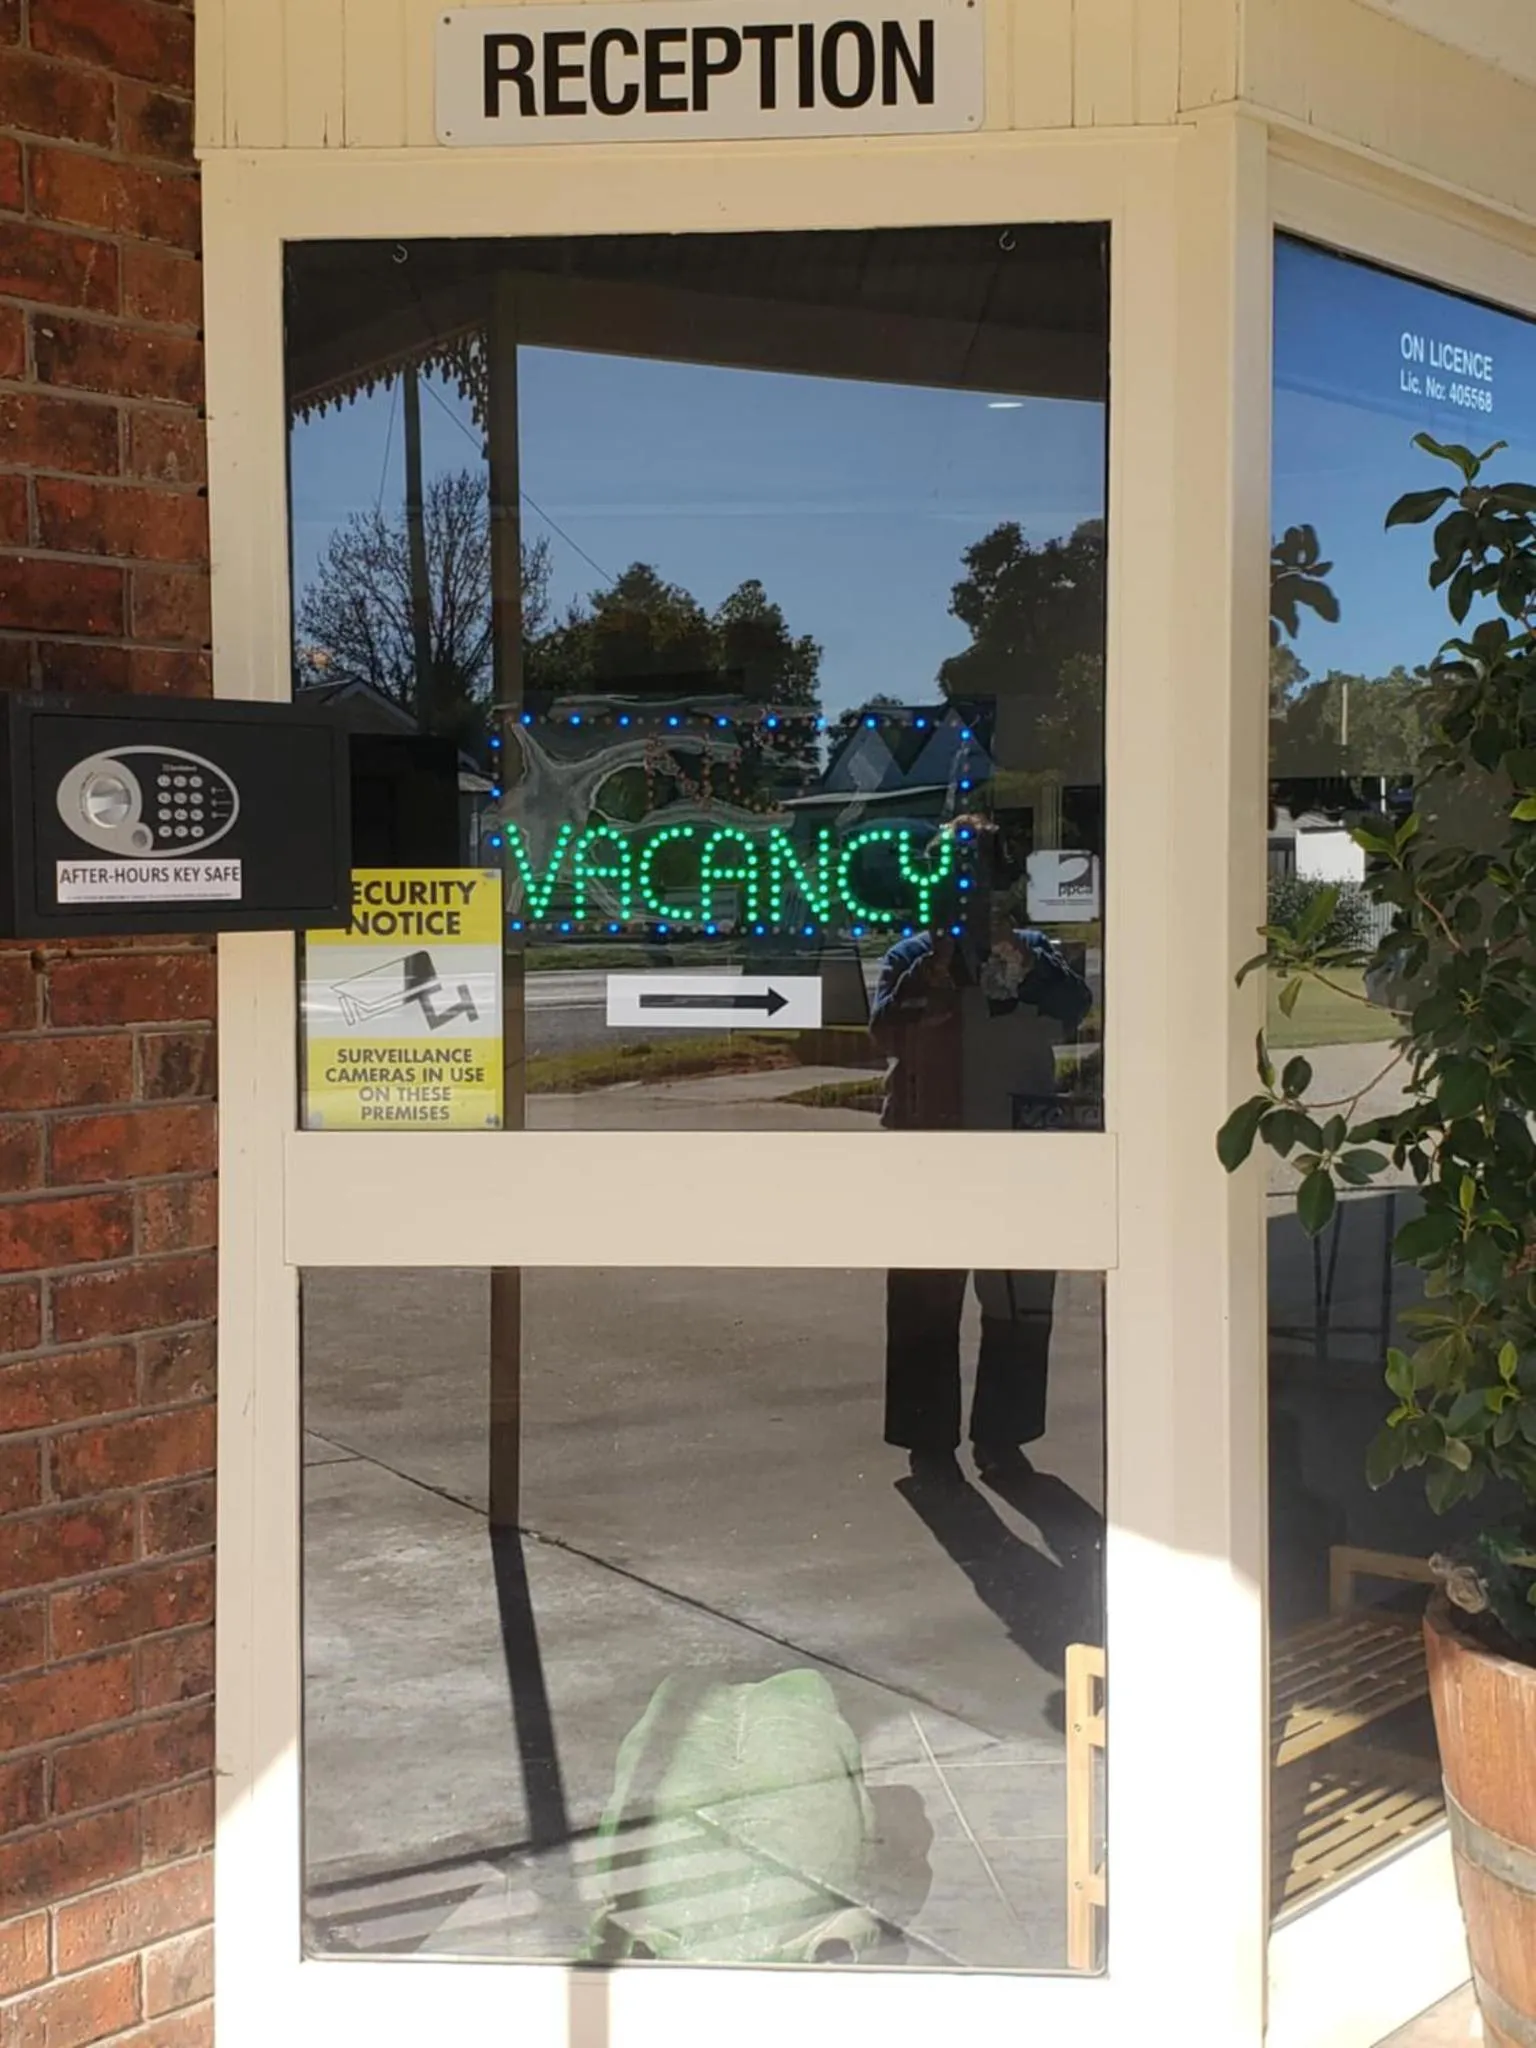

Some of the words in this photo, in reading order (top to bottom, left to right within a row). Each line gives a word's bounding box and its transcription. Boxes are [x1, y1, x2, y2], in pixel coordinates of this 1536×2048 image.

[483, 19, 934, 118] RECEPTION
[1401, 332, 1424, 363] ON
[1430, 339, 1493, 382] LICENCE
[1400, 368, 1422, 395] Lic.
[1449, 382, 1493, 413] 405568
[60, 866, 169, 884] AFTER-HOURS
[174, 866, 200, 883] KEY
[204, 866, 240, 882] SAFE
[504, 822, 953, 924] VACANCY
[351, 881, 476, 906] ECURITY
[346, 911, 460, 936] NOTICE
[337, 1048, 472, 1064] SURVEILLANCE
[325, 1067, 415, 1082] CAMERAS
[423, 1067, 442, 1082] IN
[451, 1067, 484, 1082] USE
[359, 1087, 391, 1102] ON
[398, 1086, 451, 1102] THESE
[361, 1106, 450, 1121] PREMISES
